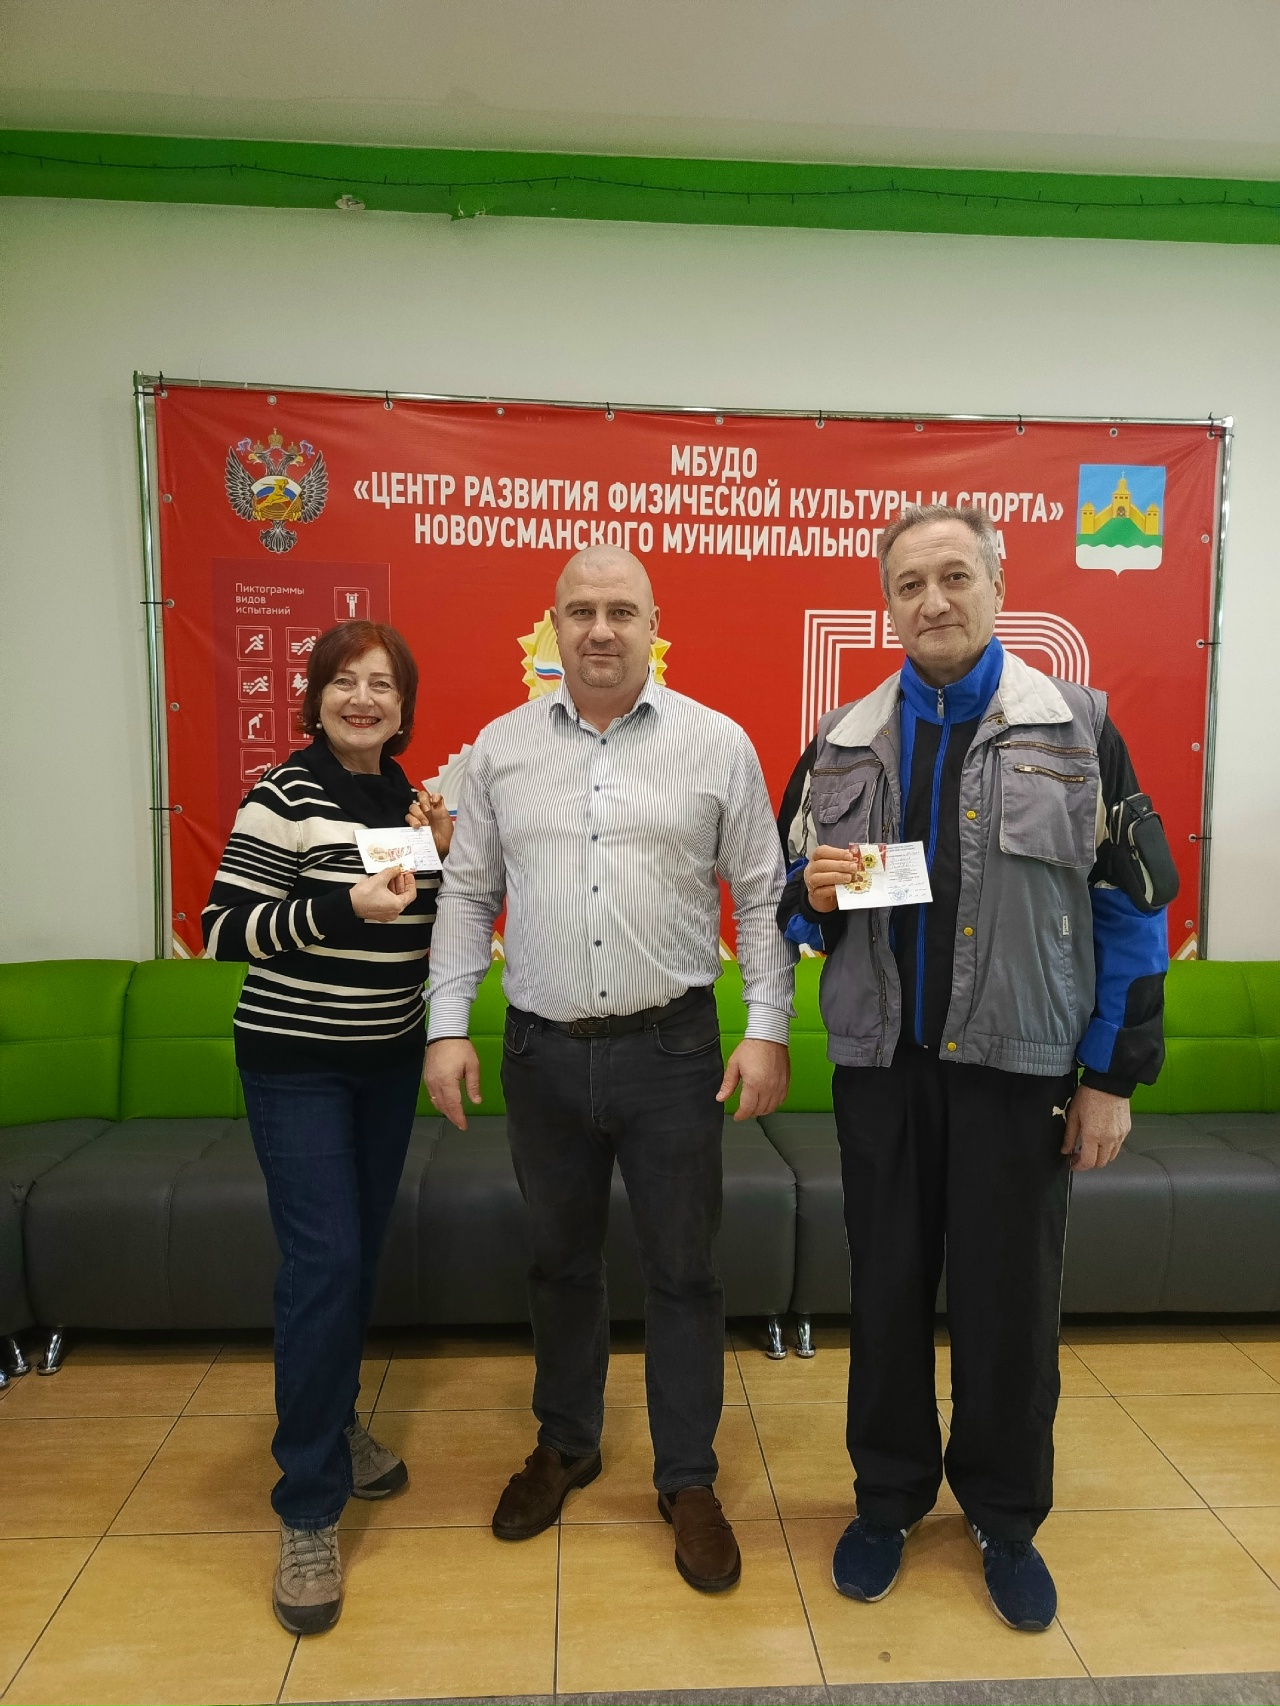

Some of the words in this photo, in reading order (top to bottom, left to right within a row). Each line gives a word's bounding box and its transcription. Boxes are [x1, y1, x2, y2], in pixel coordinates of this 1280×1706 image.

[671, 445, 757, 483] МБУДО
[353, 471, 456, 509] «ЦЕНТР
[464, 476, 598, 512] РАЗВИТИЯ
[608, 479, 781, 518] ФИЗИЧЕСКОЙ
[415, 513, 654, 553] НОВОУСМАНСКОГО
[662, 522, 884, 562] МУНИЦИПАЛЬНОГ
[235, 582, 305, 596] Пиктограммы
[235, 595, 267, 604] видов
[235, 605, 291, 615] испытаний
